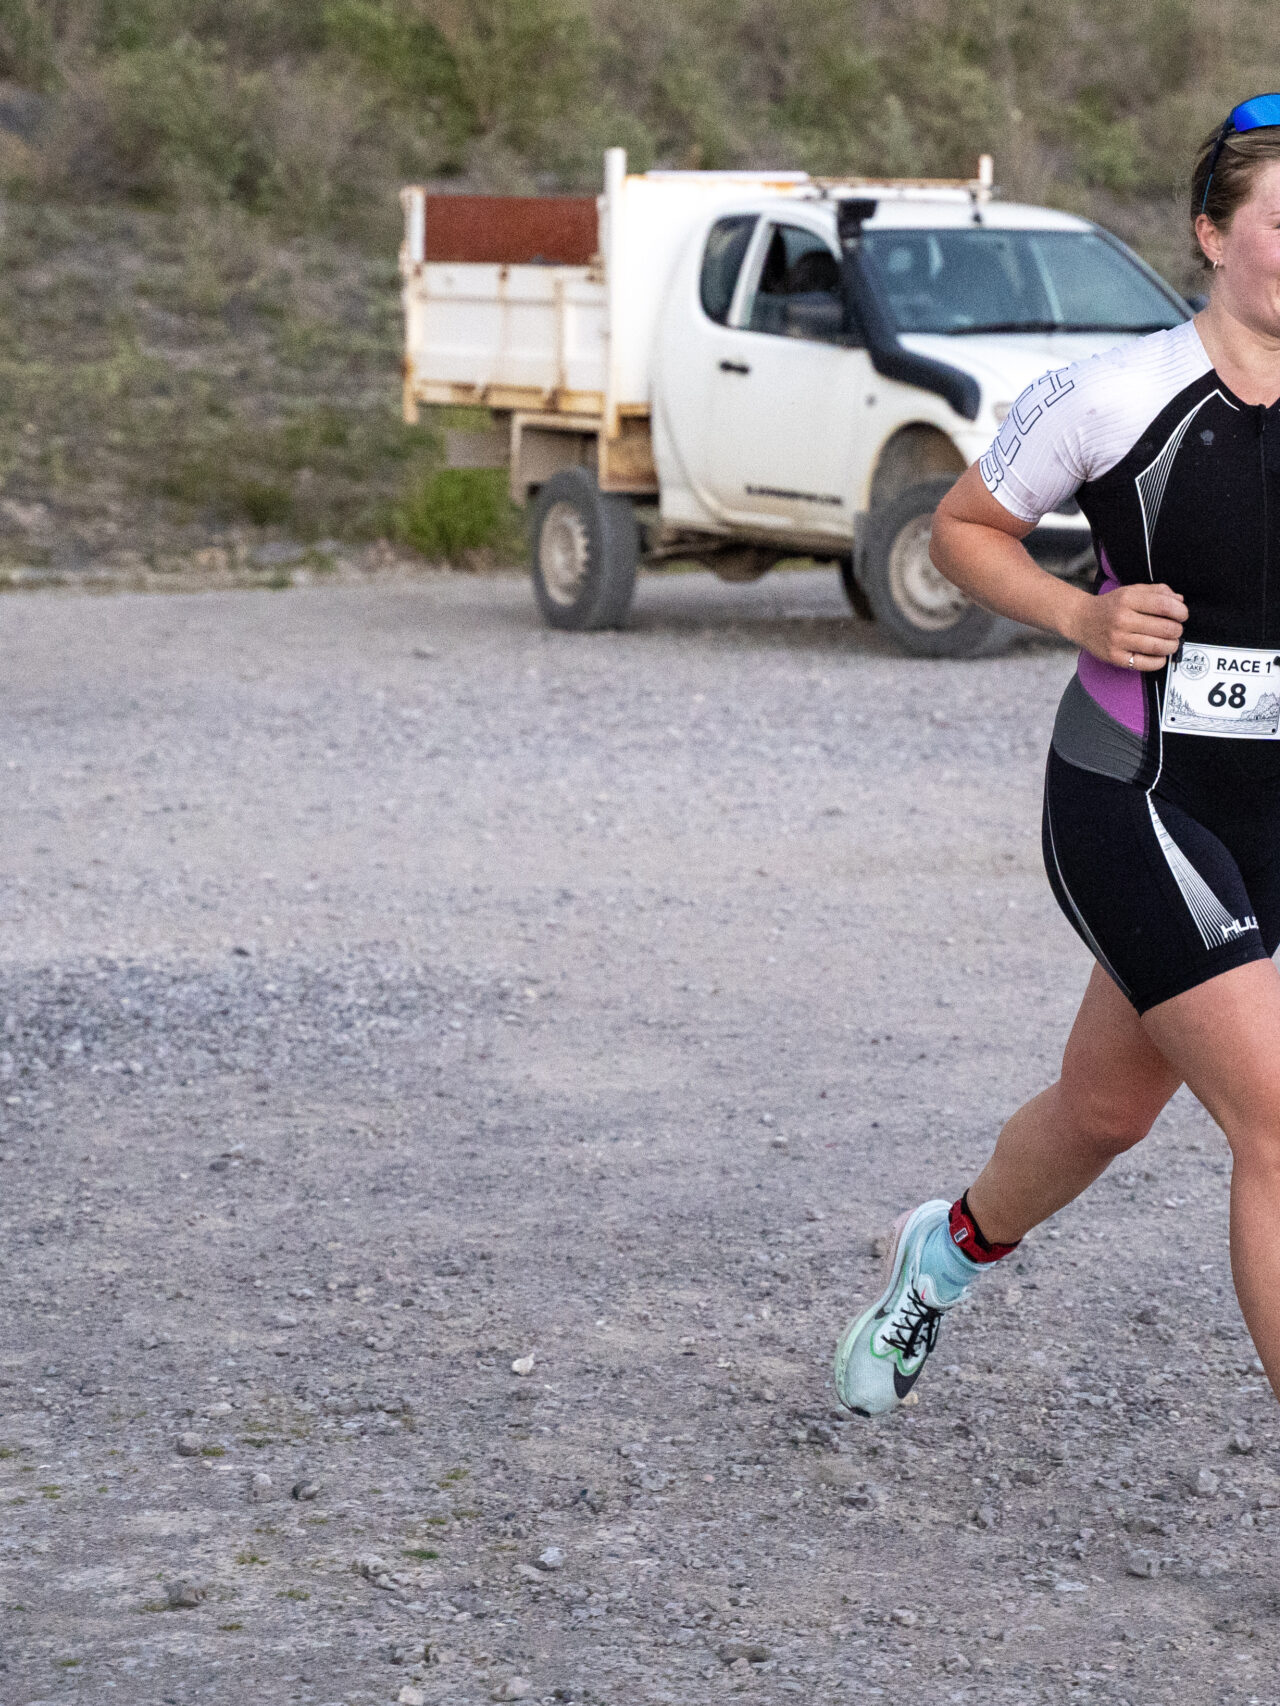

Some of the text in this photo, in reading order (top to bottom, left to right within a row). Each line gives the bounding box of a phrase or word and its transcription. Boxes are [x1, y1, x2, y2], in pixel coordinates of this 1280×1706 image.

[1185, 664, 1203, 672] LAKE
[1216, 657, 1272, 674] RACE 1
[1207, 681, 1247, 709] 68
[1220, 915, 1259, 938] HUU
